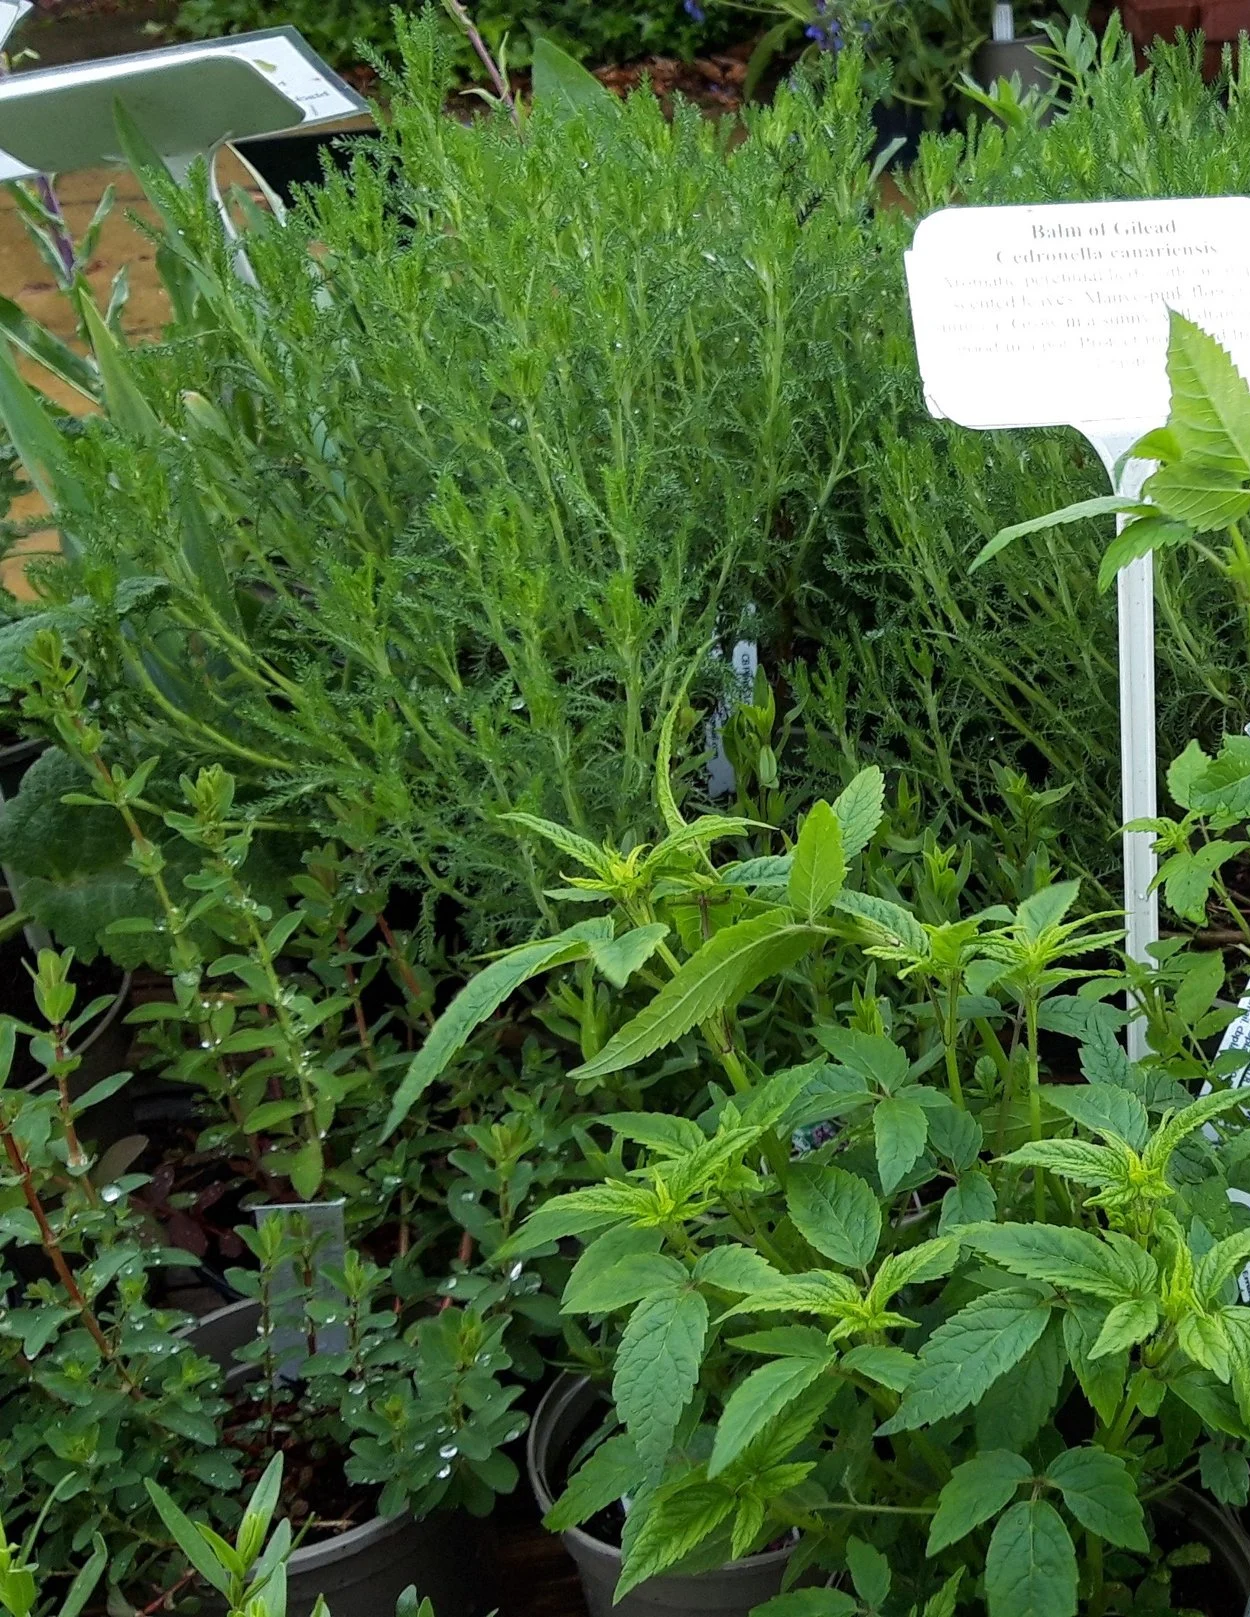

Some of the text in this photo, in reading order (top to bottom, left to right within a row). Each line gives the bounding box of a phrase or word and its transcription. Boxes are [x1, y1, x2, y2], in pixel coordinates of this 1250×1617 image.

[1031, 219, 1177, 240] Balm of Gilead
[996, 247, 1102, 265] Cedronella
